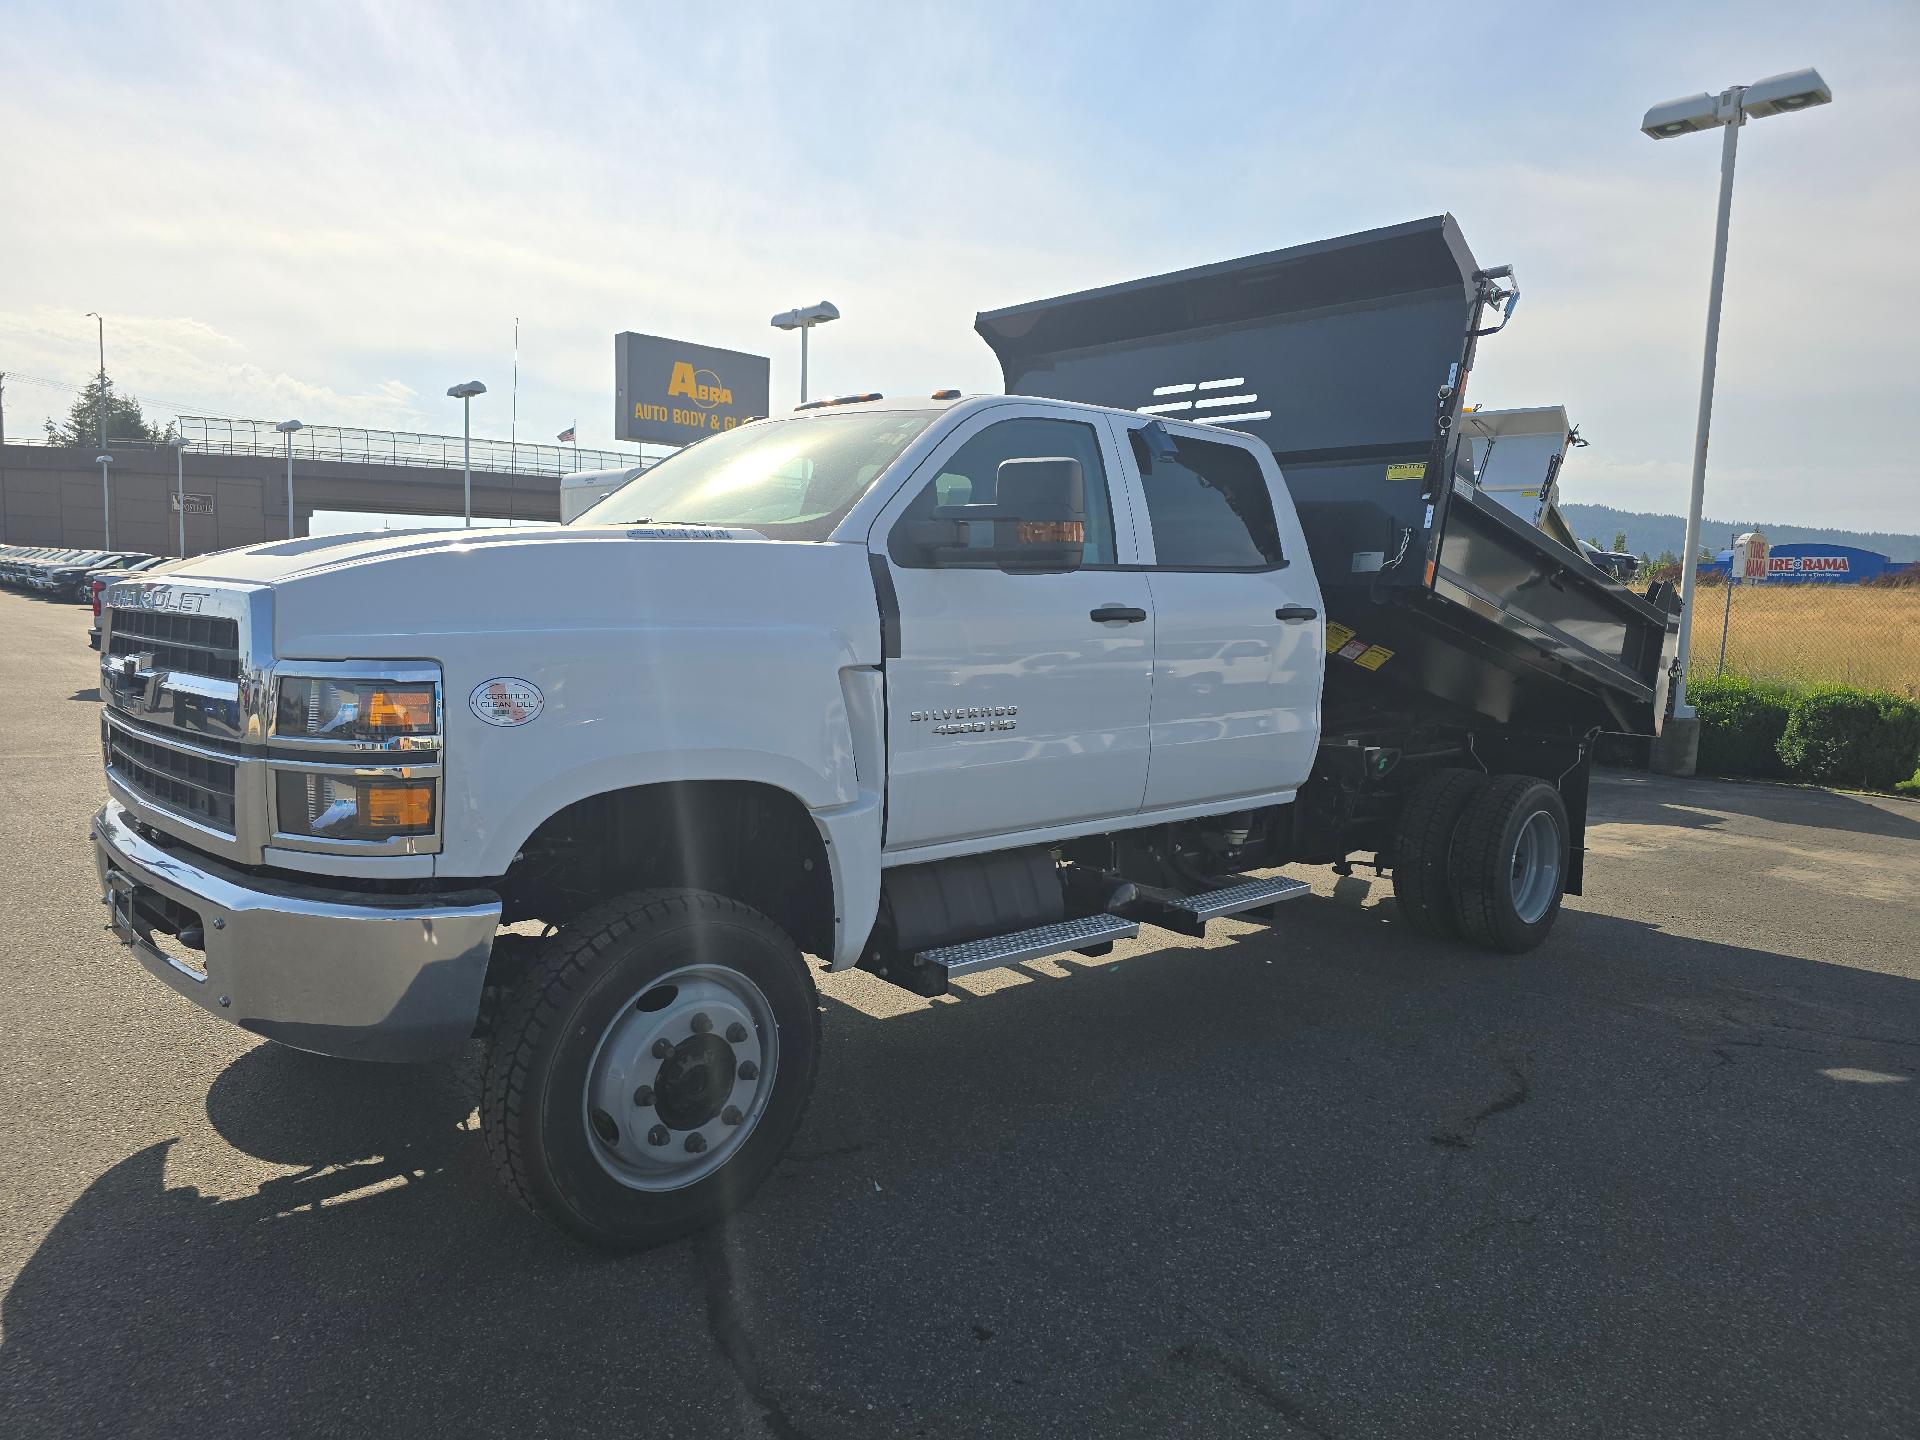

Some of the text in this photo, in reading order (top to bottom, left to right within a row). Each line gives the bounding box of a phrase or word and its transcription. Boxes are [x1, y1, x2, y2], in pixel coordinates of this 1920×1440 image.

[668, 361, 733, 405] ABRA
[634, 402, 669, 422] AUTO
[673, 408, 707, 428] BODY
[710, 416, 721, 430] &
[1750, 540, 1765, 559] TIRE
[1746, 559, 1765, 577] RAMA
[1769, 558, 1794, 571] IRE
[1803, 558, 1849, 571] RAMA
[910, 705, 1017, 722] SILVERADO
[990, 720, 1017, 732] HD
